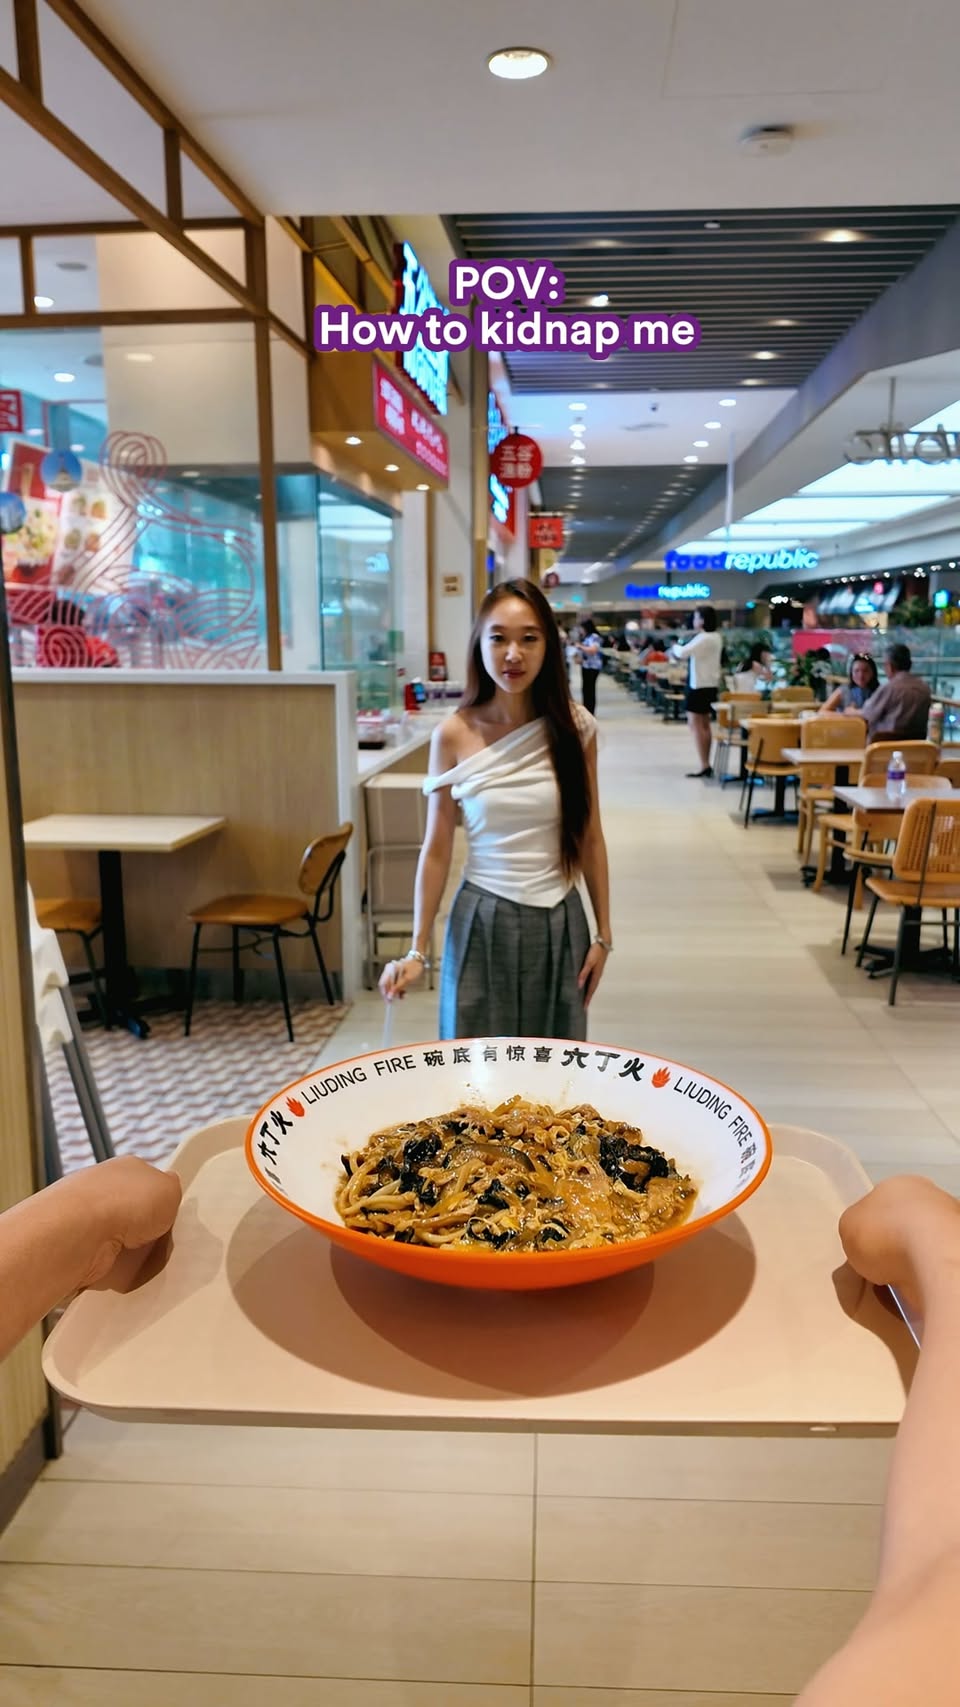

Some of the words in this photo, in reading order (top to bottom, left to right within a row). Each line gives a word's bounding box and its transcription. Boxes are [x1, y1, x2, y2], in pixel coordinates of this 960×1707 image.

[300, 1066, 368, 1105] LIUDING
[372, 1054, 417, 1077] FIRE
[560, 1046, 646, 1083] 六丁火
[672, 1076, 733, 1120] LIUDING
[727, 1114, 754, 1147] FIRE
